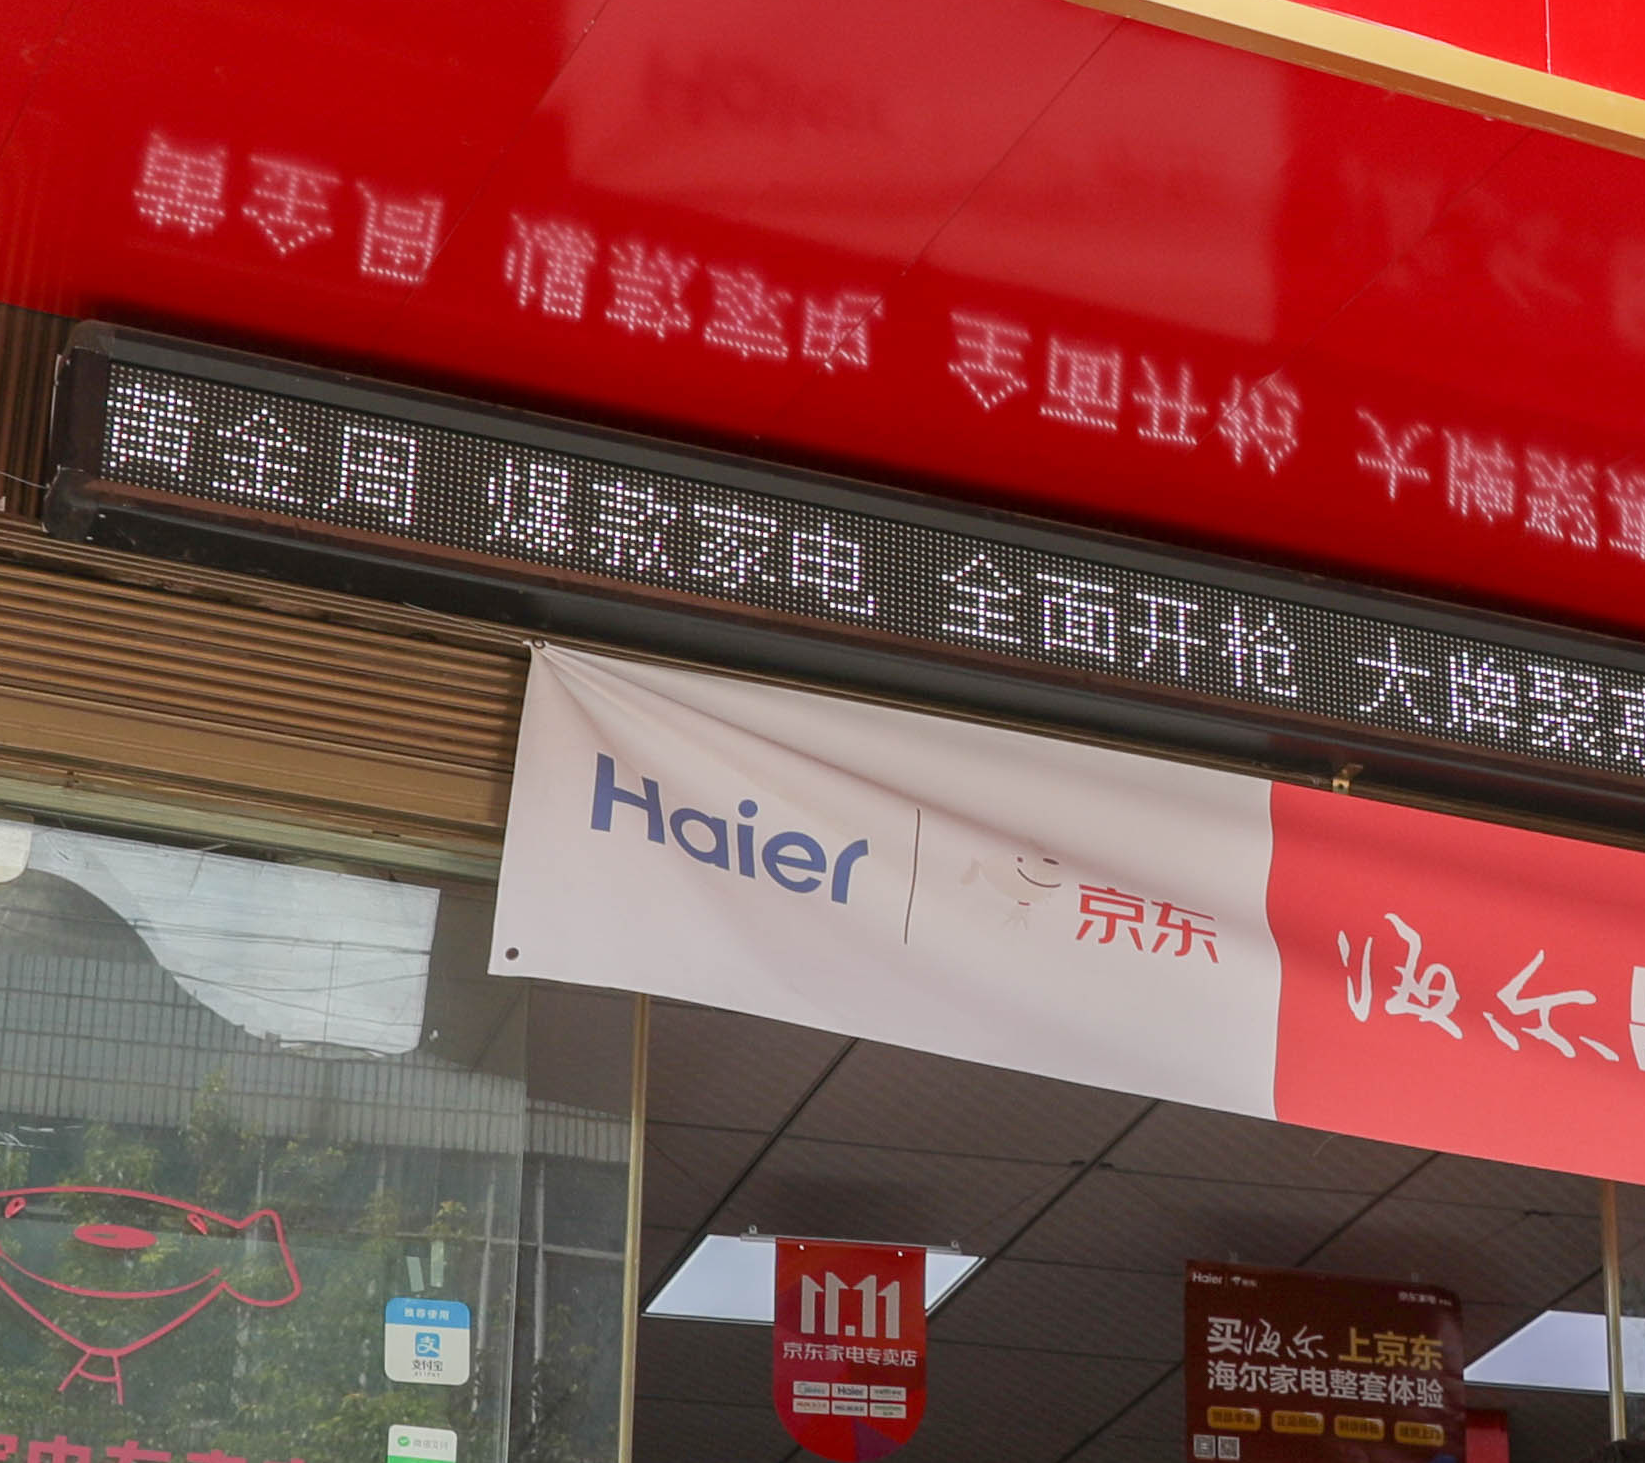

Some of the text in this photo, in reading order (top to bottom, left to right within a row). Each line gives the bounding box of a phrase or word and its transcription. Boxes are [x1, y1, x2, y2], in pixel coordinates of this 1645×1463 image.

[589, 751, 1222, 965] Haier 京东
[1192, 1272, 1223, 1285] Haier
[799, 1270, 901, 1340] 11.11
[782, 1340, 918, 1370] 京东家电专卖店
[1338, 1327, 1444, 1371] 上京东
[1207, 1359, 1444, 1409] 海尔家电整套体验
